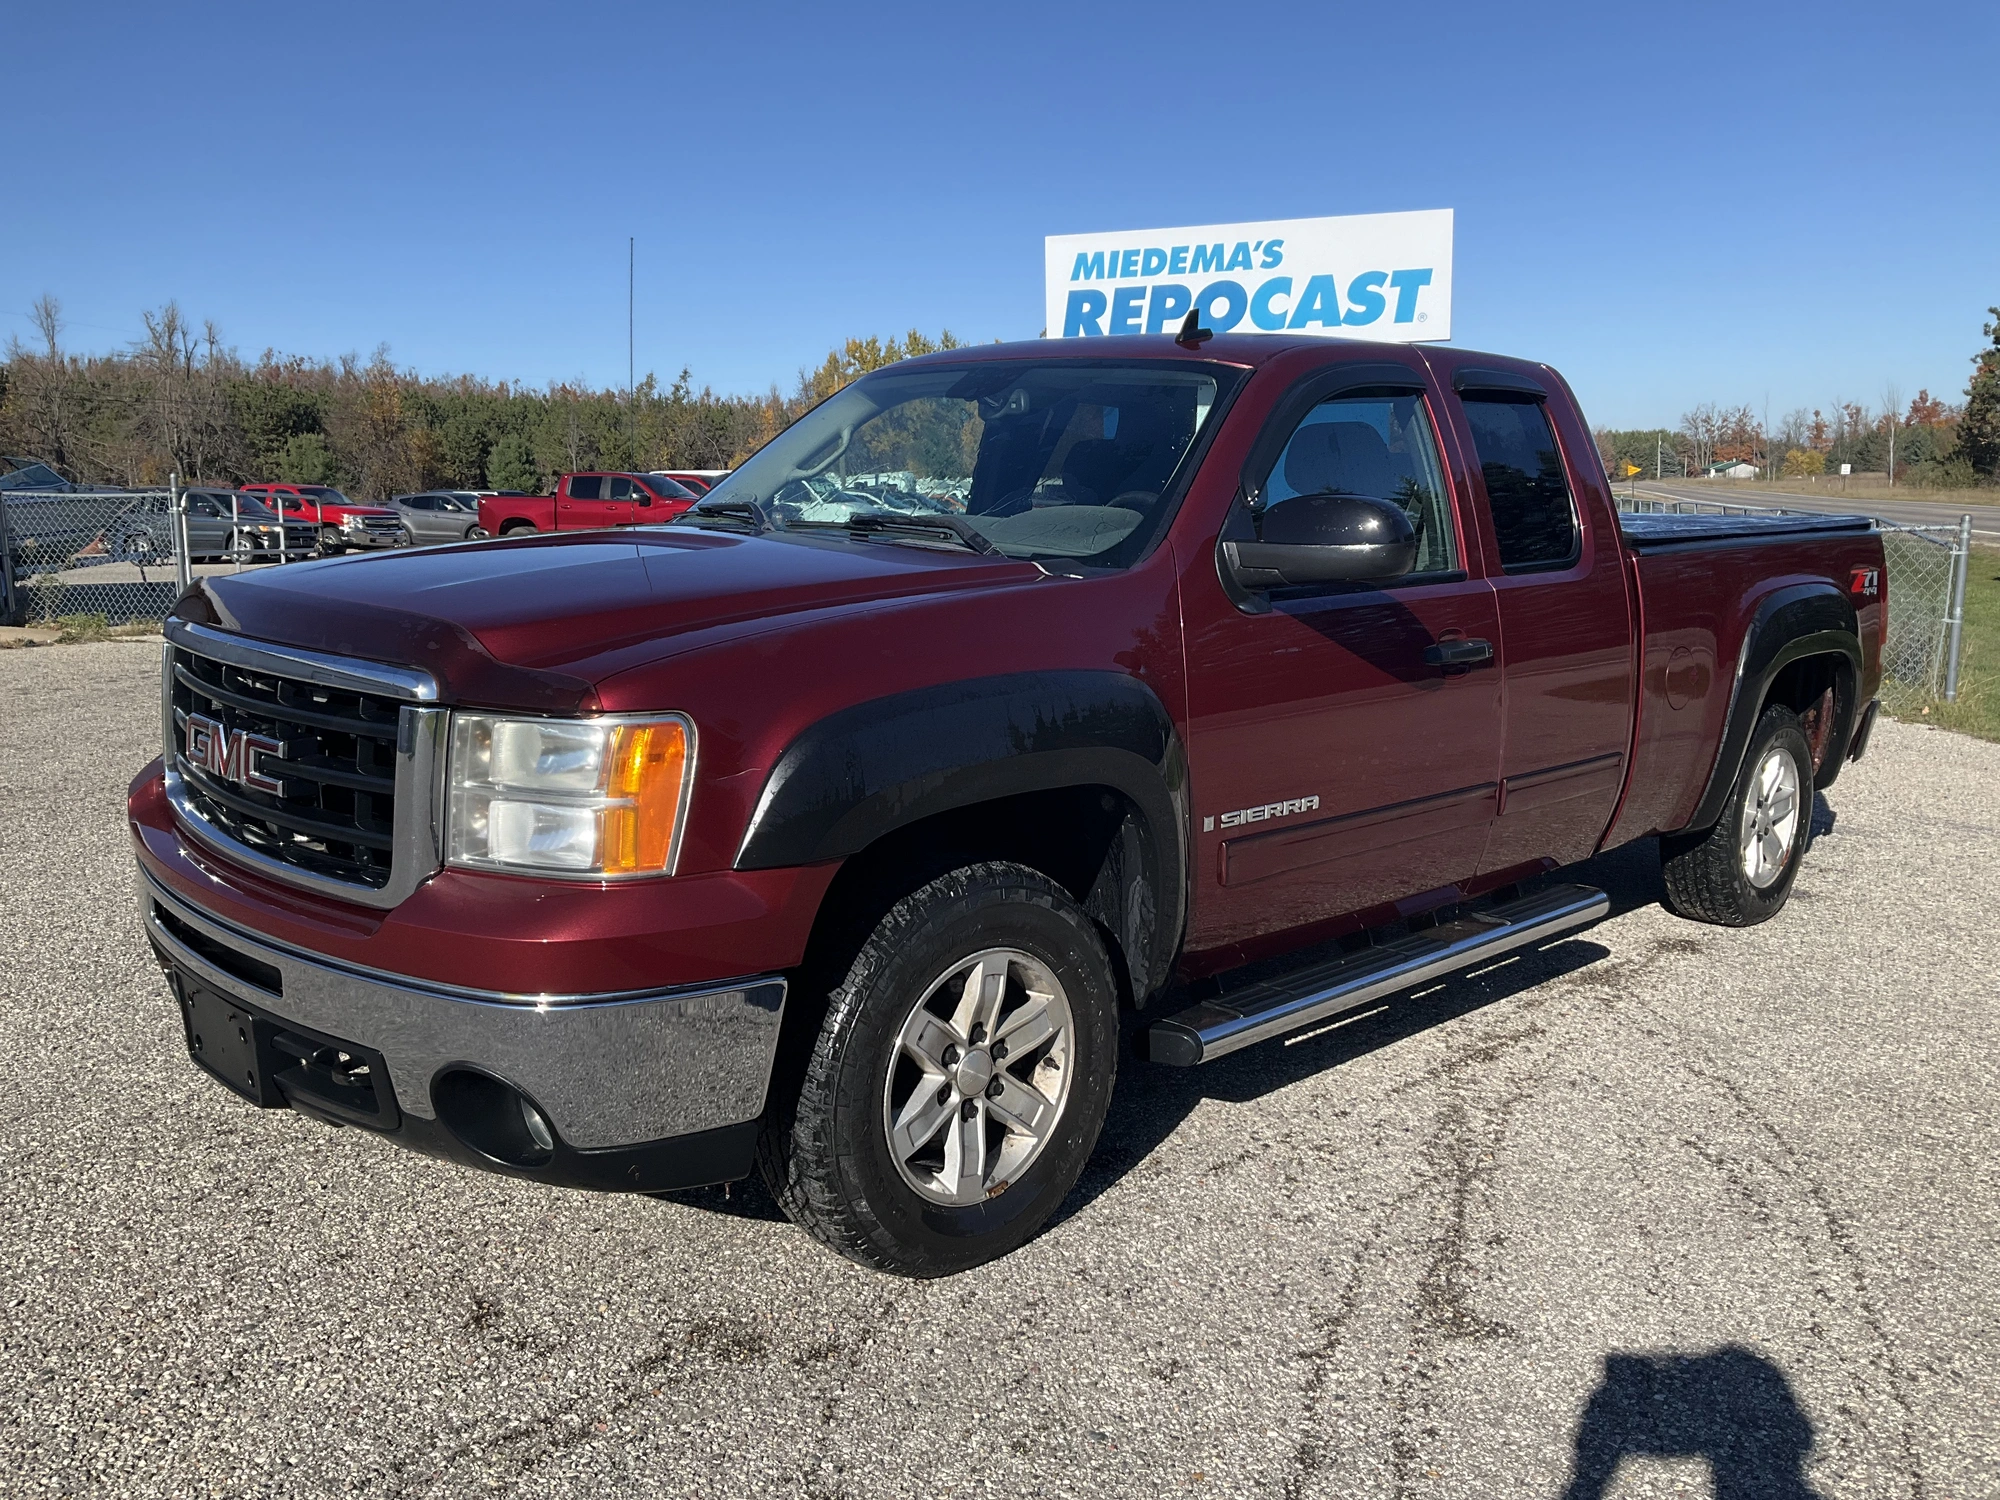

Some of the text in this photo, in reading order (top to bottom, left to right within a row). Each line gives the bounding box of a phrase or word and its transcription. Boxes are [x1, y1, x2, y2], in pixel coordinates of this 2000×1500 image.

[1070, 239, 1284, 281] MIEDEMA'S
[1063, 268, 1433, 338] REPOCAST
[1850, 568, 1878, 593] Z71
[186, 712, 287, 798] GMC
[1220, 795, 1320, 829] SIERRA
